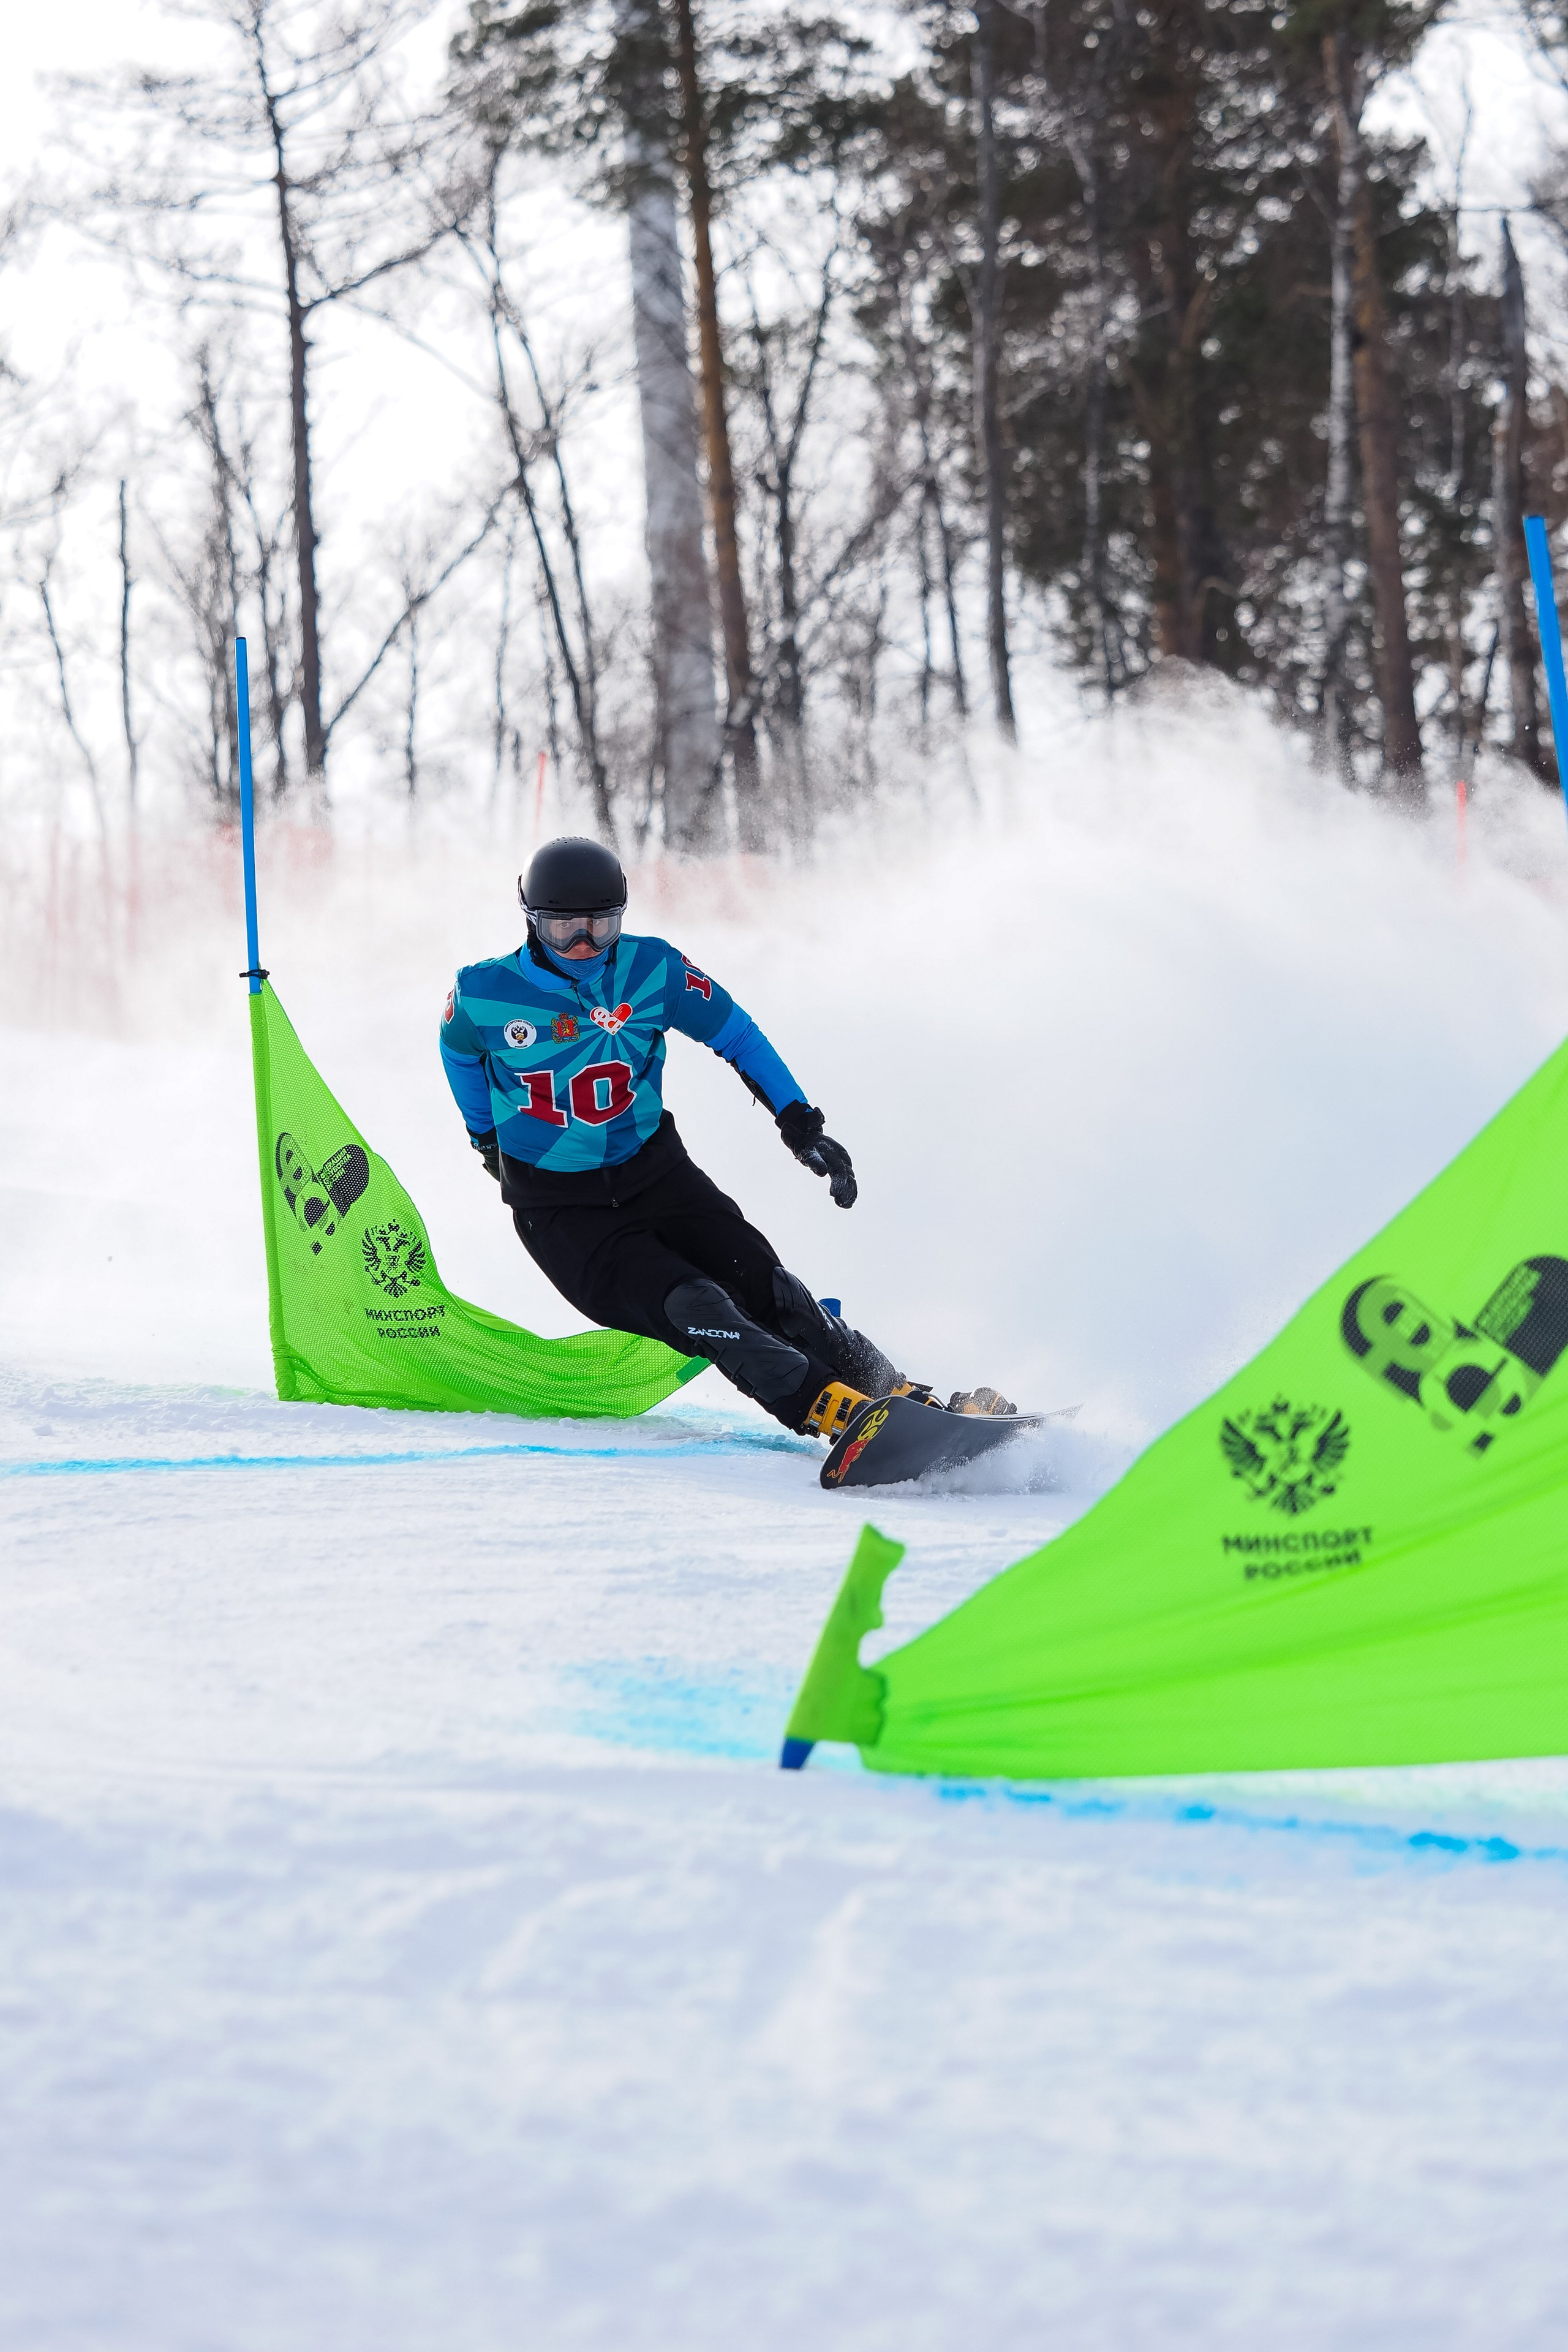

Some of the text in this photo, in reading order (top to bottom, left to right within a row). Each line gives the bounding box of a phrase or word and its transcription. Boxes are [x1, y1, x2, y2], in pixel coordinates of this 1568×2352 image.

[514, 1059, 637, 1128] 10
[364, 1305, 445, 1321] МИНСПОРТ
[377, 1325, 441, 1338] РОССИИ
[1222, 1526, 1373, 1555] МИНСПОРТ
[1243, 1549, 1361, 1580] РОССИИ
